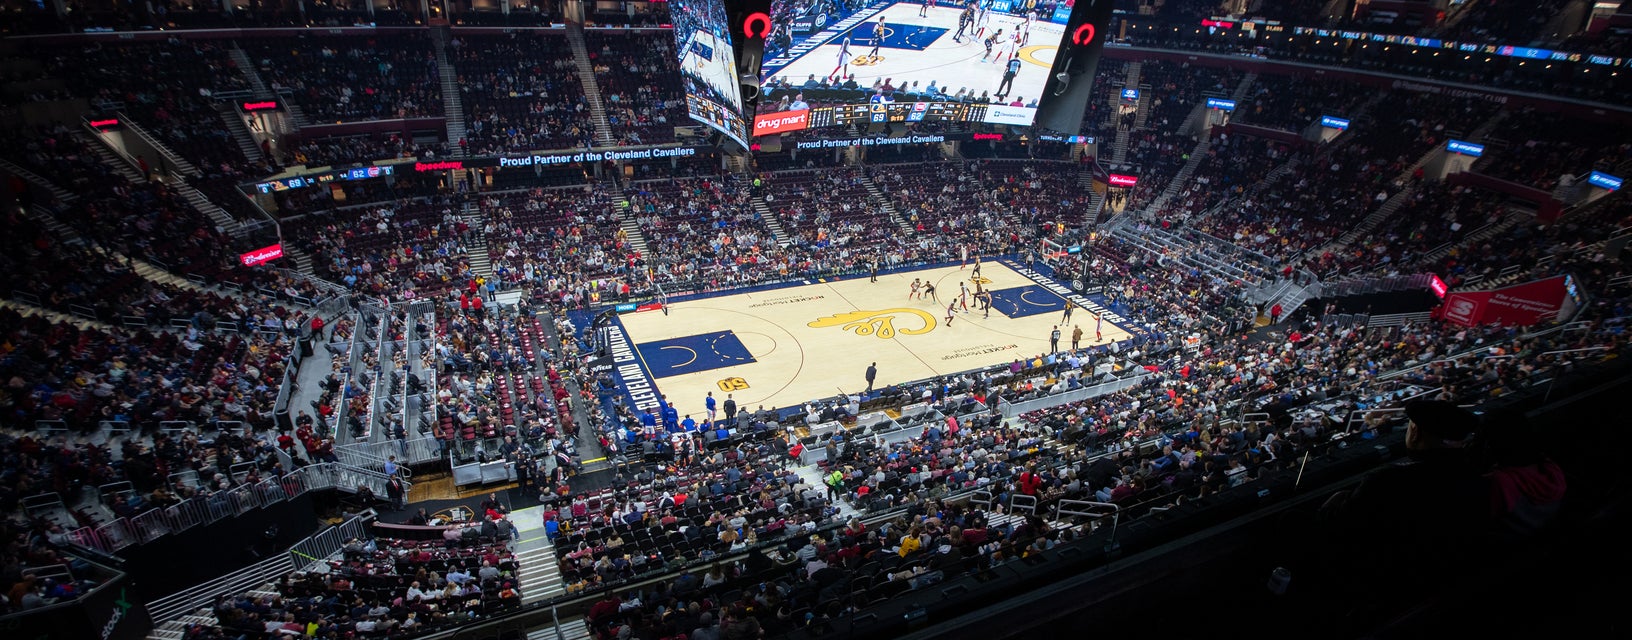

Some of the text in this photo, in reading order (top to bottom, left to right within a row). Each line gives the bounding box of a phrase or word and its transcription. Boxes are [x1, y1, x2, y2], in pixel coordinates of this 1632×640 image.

[757, 116, 780, 129] drug
[781, 114, 805, 125] mart
[873, 113, 885, 122] 69
[822, 139, 850, 148] Partner
[852, 138, 860, 146] of
[861, 137, 874, 145] the
[876, 135, 910, 145] Cleveland
[912, 134, 945, 143] Cavaliers
[500, 146, 695, 167] Proud Partner of the Cleveland Cavaliers
[415, 161, 464, 172] Speedway
[288, 179, 301, 188] 69
[353, 170, 364, 178] 62
[243, 249, 281, 265] Budweiser
[1067, 294, 1126, 323] CAVALIERS
[608, 325, 661, 411] CLEVELAND CAVALIERS
